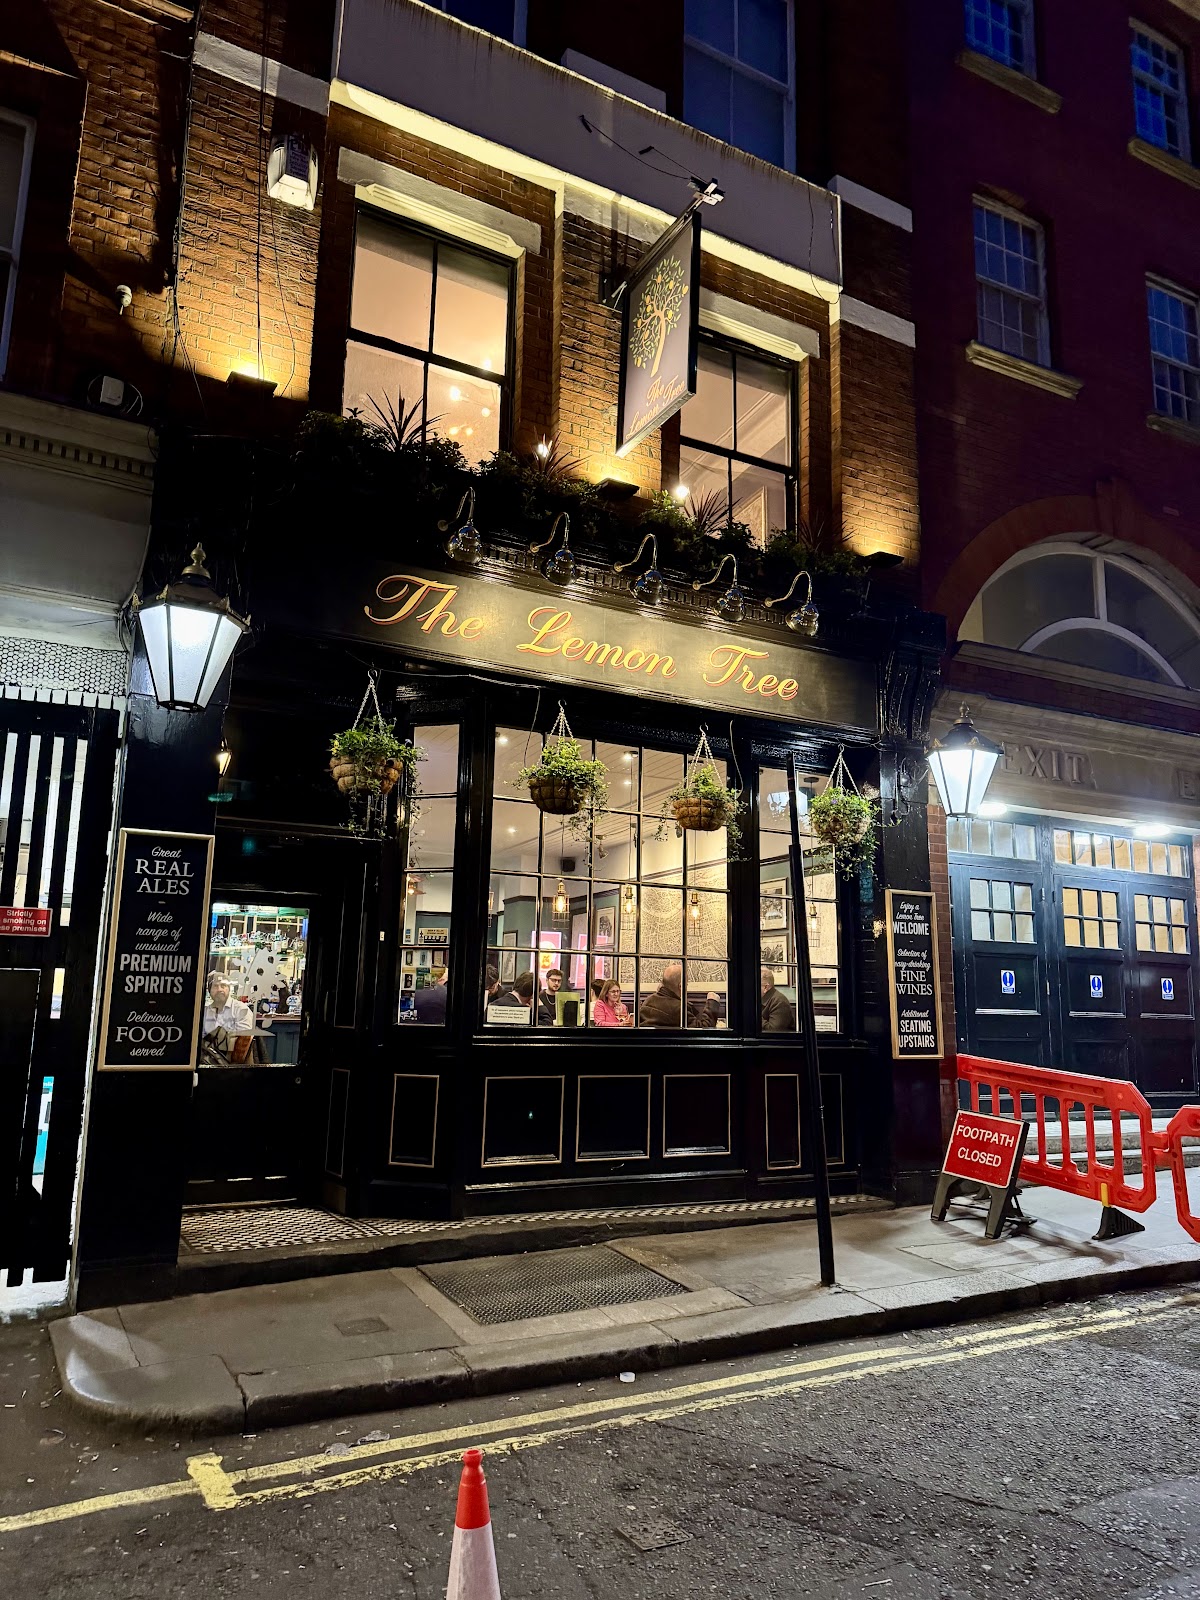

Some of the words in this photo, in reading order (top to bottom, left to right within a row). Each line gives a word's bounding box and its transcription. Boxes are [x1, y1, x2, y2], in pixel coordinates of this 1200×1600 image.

[646, 375, 665, 407] The
[662, 374, 685, 407] Tree
[626, 404, 659, 440] Lemon
[364, 574, 483, 640] The
[517, 606, 677, 678] Lemon
[703, 645, 799, 701] Tree
[1001, 742, 1085, 784] EXIT
[151, 846, 182, 858] Great
[135, 859, 194, 877] REAL
[136, 878, 190, 895] ALES
[6, 909, 33, 918] Strictly
[900, 901, 914, 913] Enjoy
[3, 917, 35, 925] smoking
[147, 911, 173, 923] Wide
[896, 911, 913, 920] Lemon
[914, 912, 925, 920] Tree
[136, 927, 169, 941] range
[170, 926, 183, 941] of
[893, 921, 930, 936] WELCOME
[135, 941, 180, 952] unusual
[120, 953, 192, 972] PREMIUM
[900, 970, 927, 982] FINE
[124, 975, 183, 994] SPIRITS
[896, 983, 933, 996] WINES
[126, 1011, 174, 1022] Delicious
[900, 1019, 932, 1033] SEATING
[115, 1026, 183, 1043] FOOD
[898, 1034, 935, 1048] UPSTAIRS
[129, 1045, 166, 1056] served
[956, 1124, 1015, 1148] FOOTPATH
[957, 1146, 1002, 1168] CLOSED
